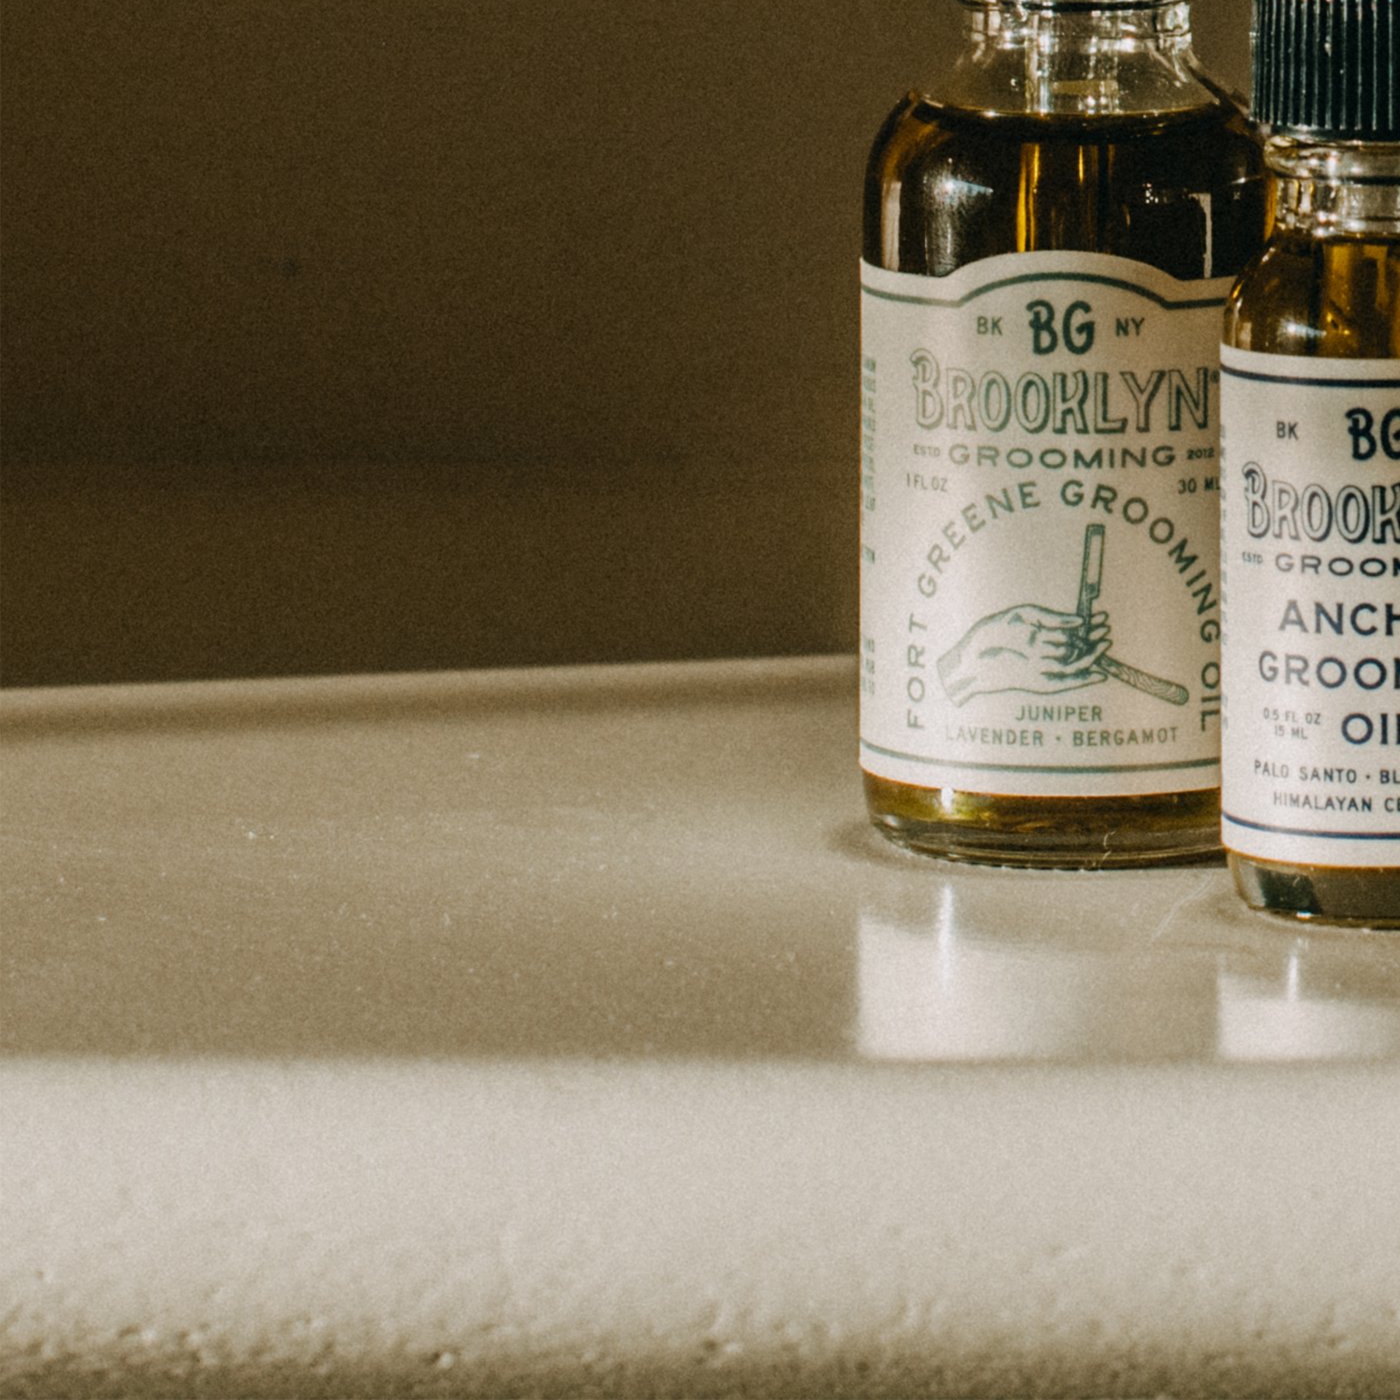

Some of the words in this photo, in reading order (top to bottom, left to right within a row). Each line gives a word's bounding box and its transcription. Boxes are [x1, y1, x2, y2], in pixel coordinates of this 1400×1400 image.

[976, 316, 1003, 336] BK
[1026, 299, 1095, 355] BG
[1115, 316, 1145, 337] NY
[1276, 421, 1299, 441] BK
[948, 444, 1176, 469] GROOMING
[913, 473, 928, 491] FL
[931, 475, 948, 492] OZ
[1178, 478, 1198, 494] 30
[917, 481, 1042, 599] GREENE
[1060, 479, 1221, 644] GROOMING
[907, 613, 928, 730] FORT
[1201, 661, 1221, 732] OIL
[1015, 706, 1103, 723] JUNIPER
[1284, 710, 1299, 723] FL
[1305, 712, 1321, 726] OZ
[945, 726, 1044, 748] LAVENDER
[1073, 726, 1178, 747] BERGAMOT
[1290, 727, 1308, 740] ML
[1254, 759, 1290, 778] PALO
[1299, 766, 1358, 784] SANTO
[1273, 791, 1373, 813] HIMALAYAN
